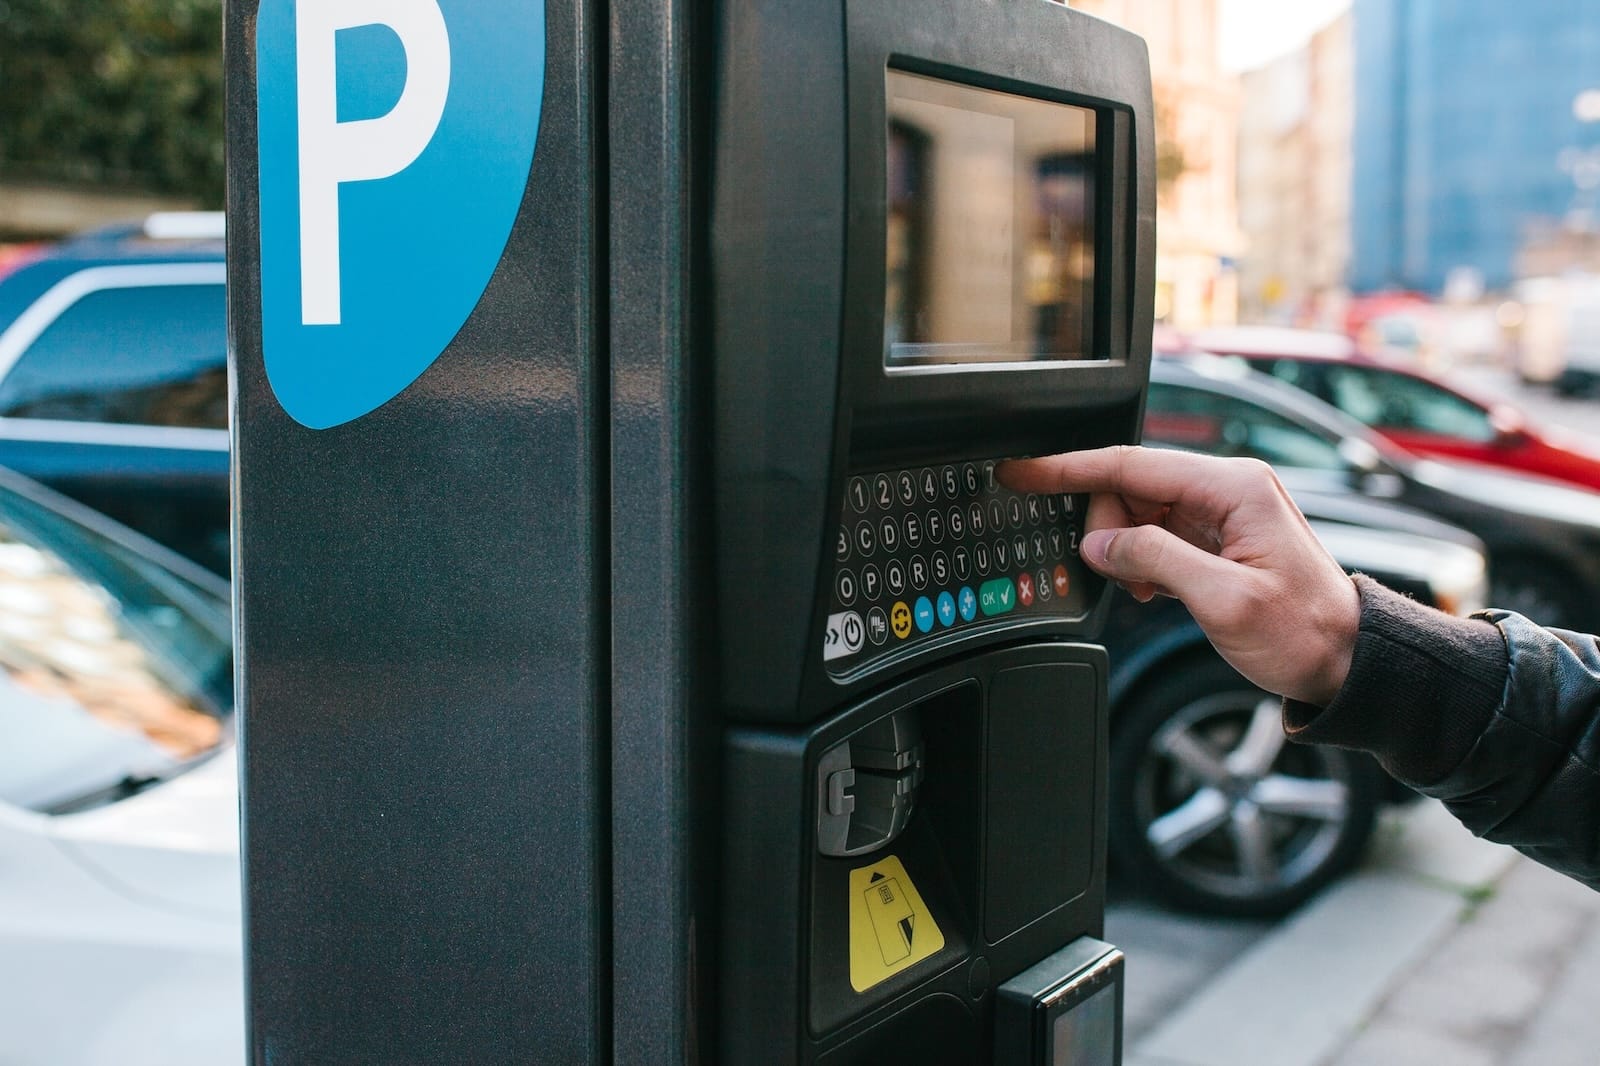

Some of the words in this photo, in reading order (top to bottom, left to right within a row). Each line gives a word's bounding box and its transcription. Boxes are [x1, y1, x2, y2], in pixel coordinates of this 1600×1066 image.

[296, 0, 451, 326] P
[855, 482, 864, 507] 1
[879, 480, 889, 504] 2
[902, 476, 912, 500] 3
[925, 474, 935, 497] 4
[946, 471, 956, 493] 5
[967, 468, 976, 490] 6
[985, 466, 994, 487] 7
[860, 528, 871, 549] C
[884, 524, 895, 545] D
[908, 520, 918, 540] E
[931, 517, 939, 537] F
[951, 513, 961, 533] G
[972, 510, 982, 529] H
[994, 507, 999, 525] I
[1012, 503, 1019, 522] J
[1029, 500, 1039, 518] K
[1047, 498, 1056, 516] L
[1063, 495, 1073, 512] M
[840, 577, 853, 598] O
[866, 572, 876, 593] P
[890, 567, 902, 588] Q
[913, 563, 924, 583] R
[936, 558, 946, 578] S
[957, 553, 965, 573] T
[977, 549, 987, 569] U
[996, 545, 1005, 564] V
[1014, 541, 1026, 561] W
[1034, 538, 1043, 557] X
[1052, 535, 1060, 553] Y
[1069, 531, 1077, 549] Z
[982, 591, 996, 606] OK
